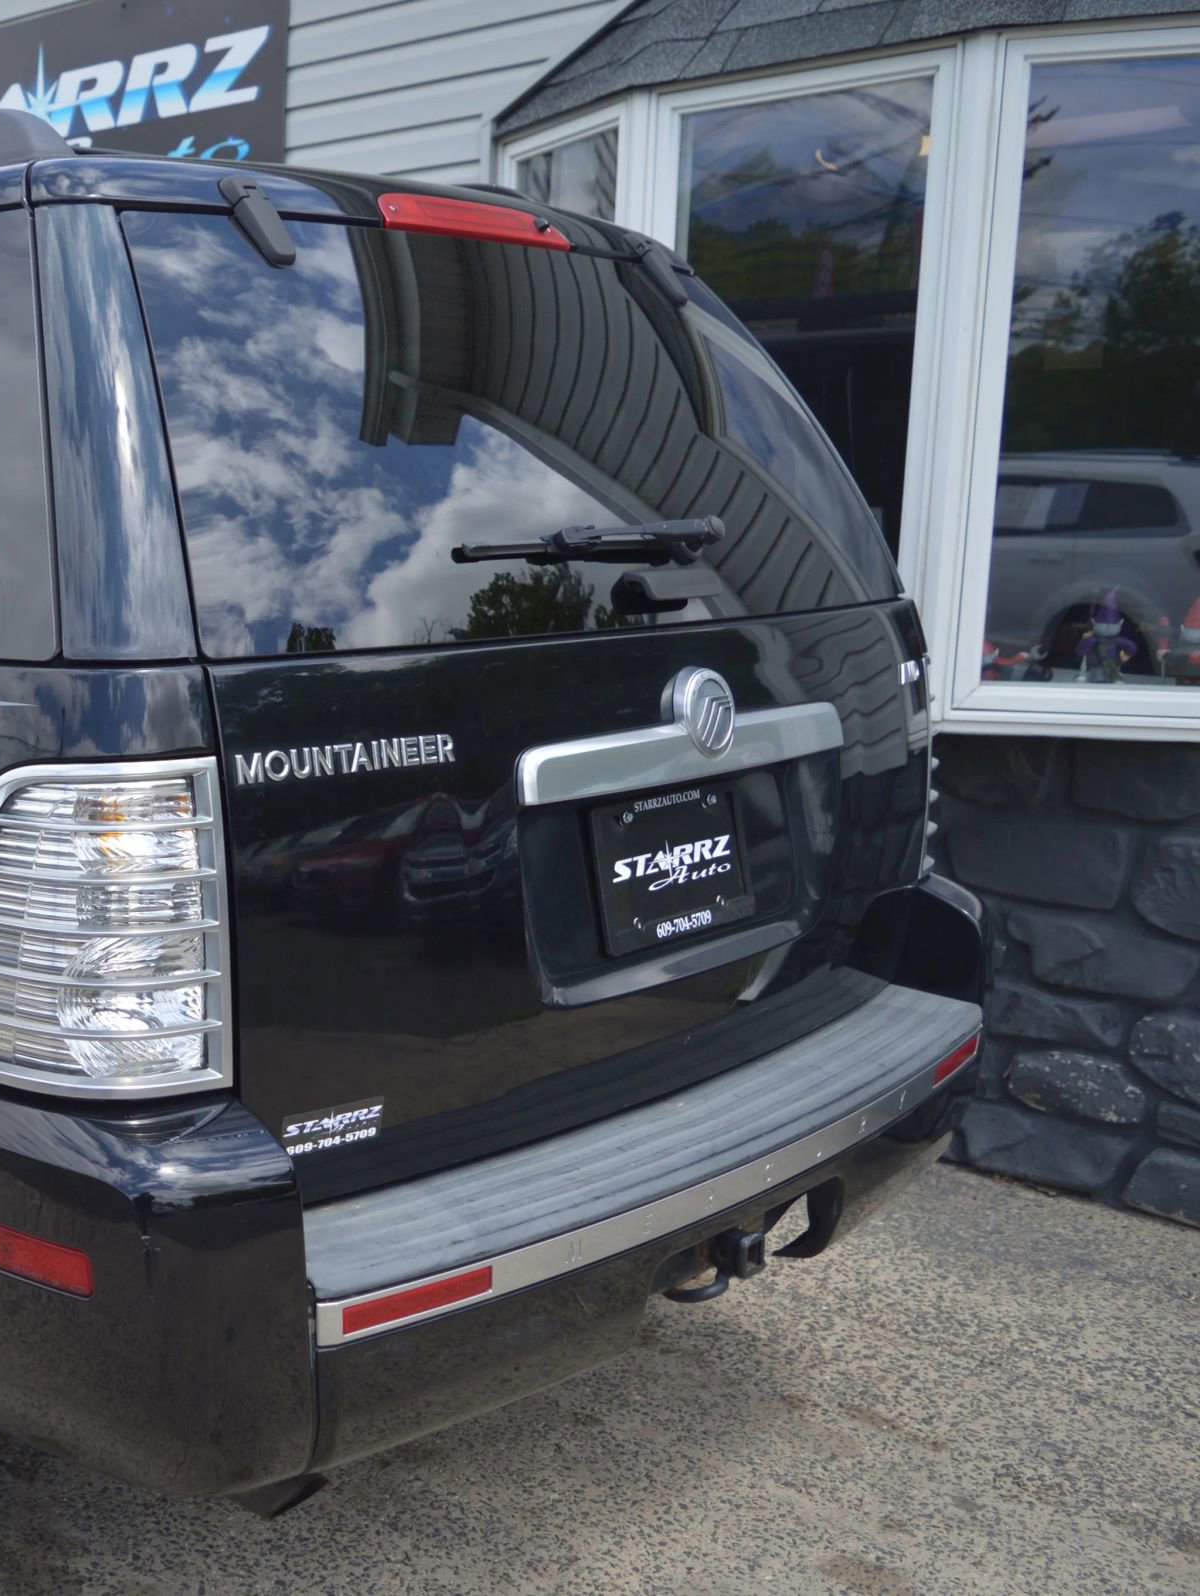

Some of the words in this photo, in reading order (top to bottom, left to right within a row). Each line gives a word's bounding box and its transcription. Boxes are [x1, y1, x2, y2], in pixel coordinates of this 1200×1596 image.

[234, 733, 456, 786] MOUNTAINEER
[634, 789, 700, 813] STARRZAUTO.COM
[612, 834, 731, 884] STARRZ
[648, 862, 731, 891] Auto
[656, 909, 712, 939] 609-704-5709
[282, 1104, 383, 1138] STARRZ
[286, 1126, 377, 1156] 609-704-5709
